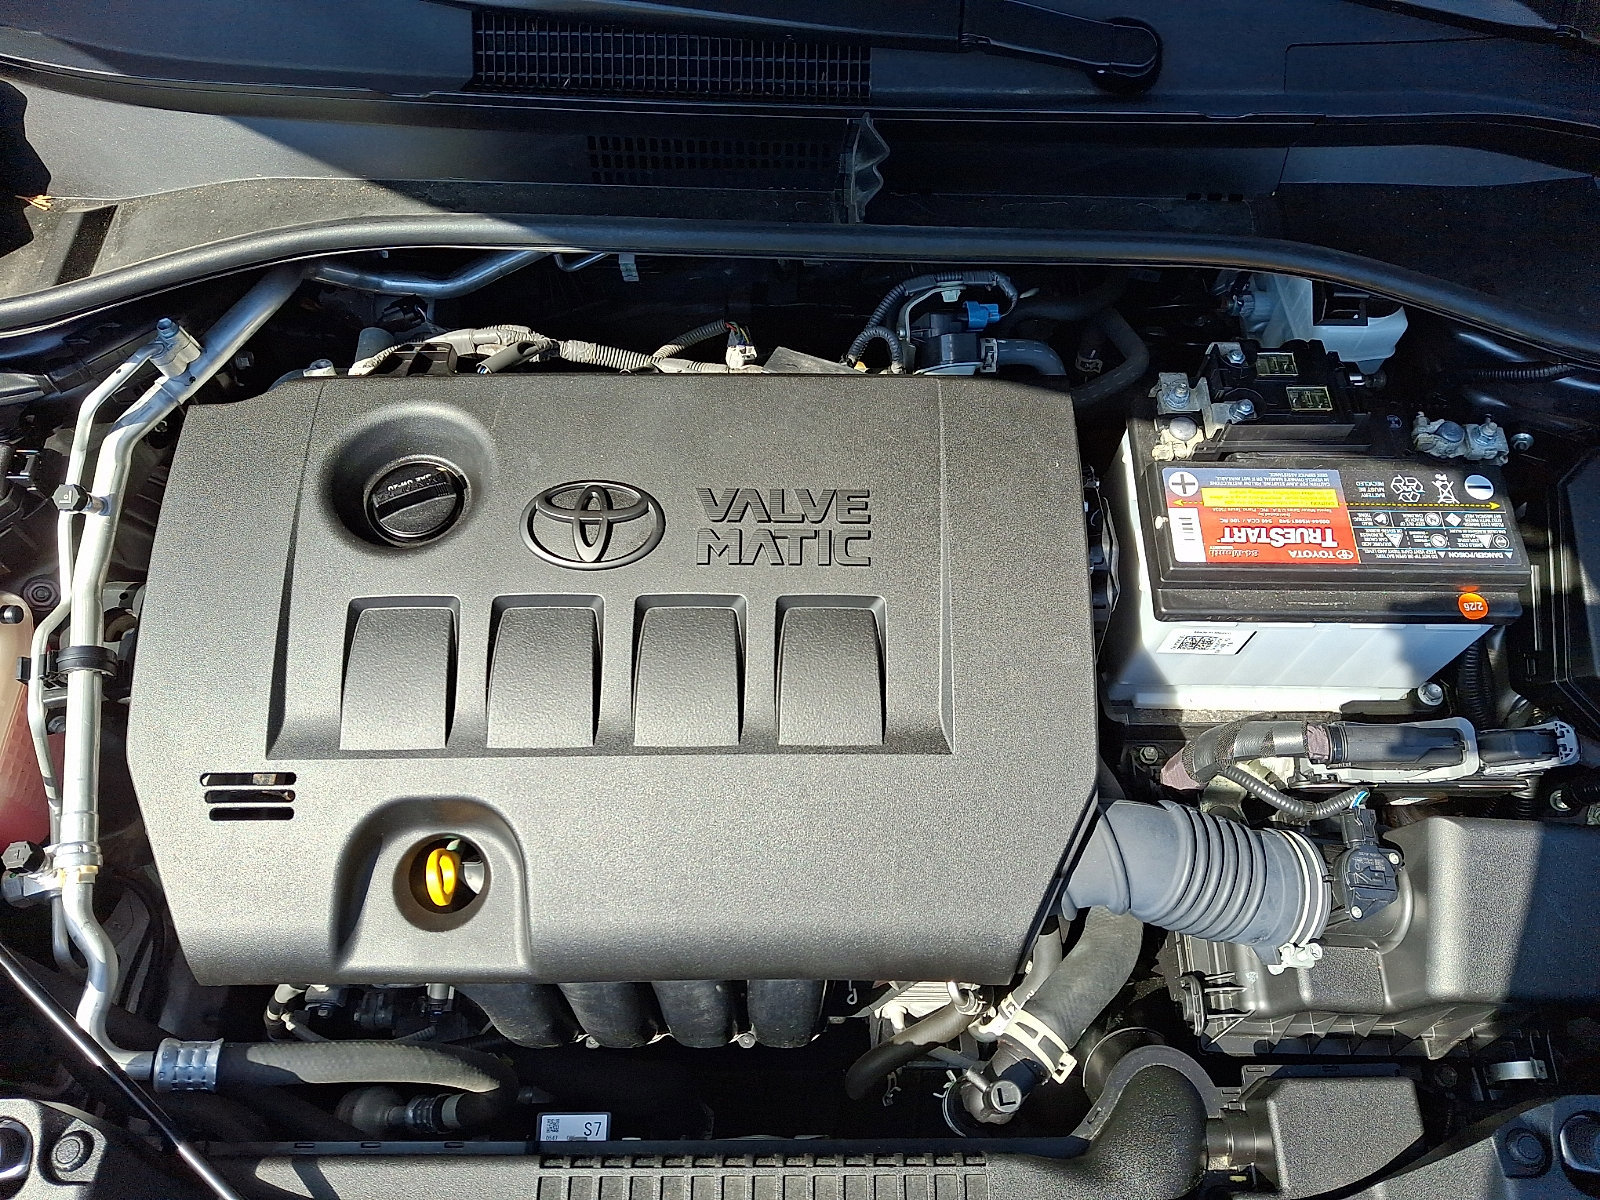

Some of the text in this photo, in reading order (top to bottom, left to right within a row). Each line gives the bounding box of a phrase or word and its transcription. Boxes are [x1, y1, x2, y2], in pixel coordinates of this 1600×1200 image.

[696, 487, 871, 525] VALVE
[696, 528, 871, 567] MATIC
[1288, 550, 1335, 558] TOYOTA
[1464, 601, 1484, 612] 2/26
[997, 1088, 1016, 1106] L
[584, 1122, 602, 1136] S7
